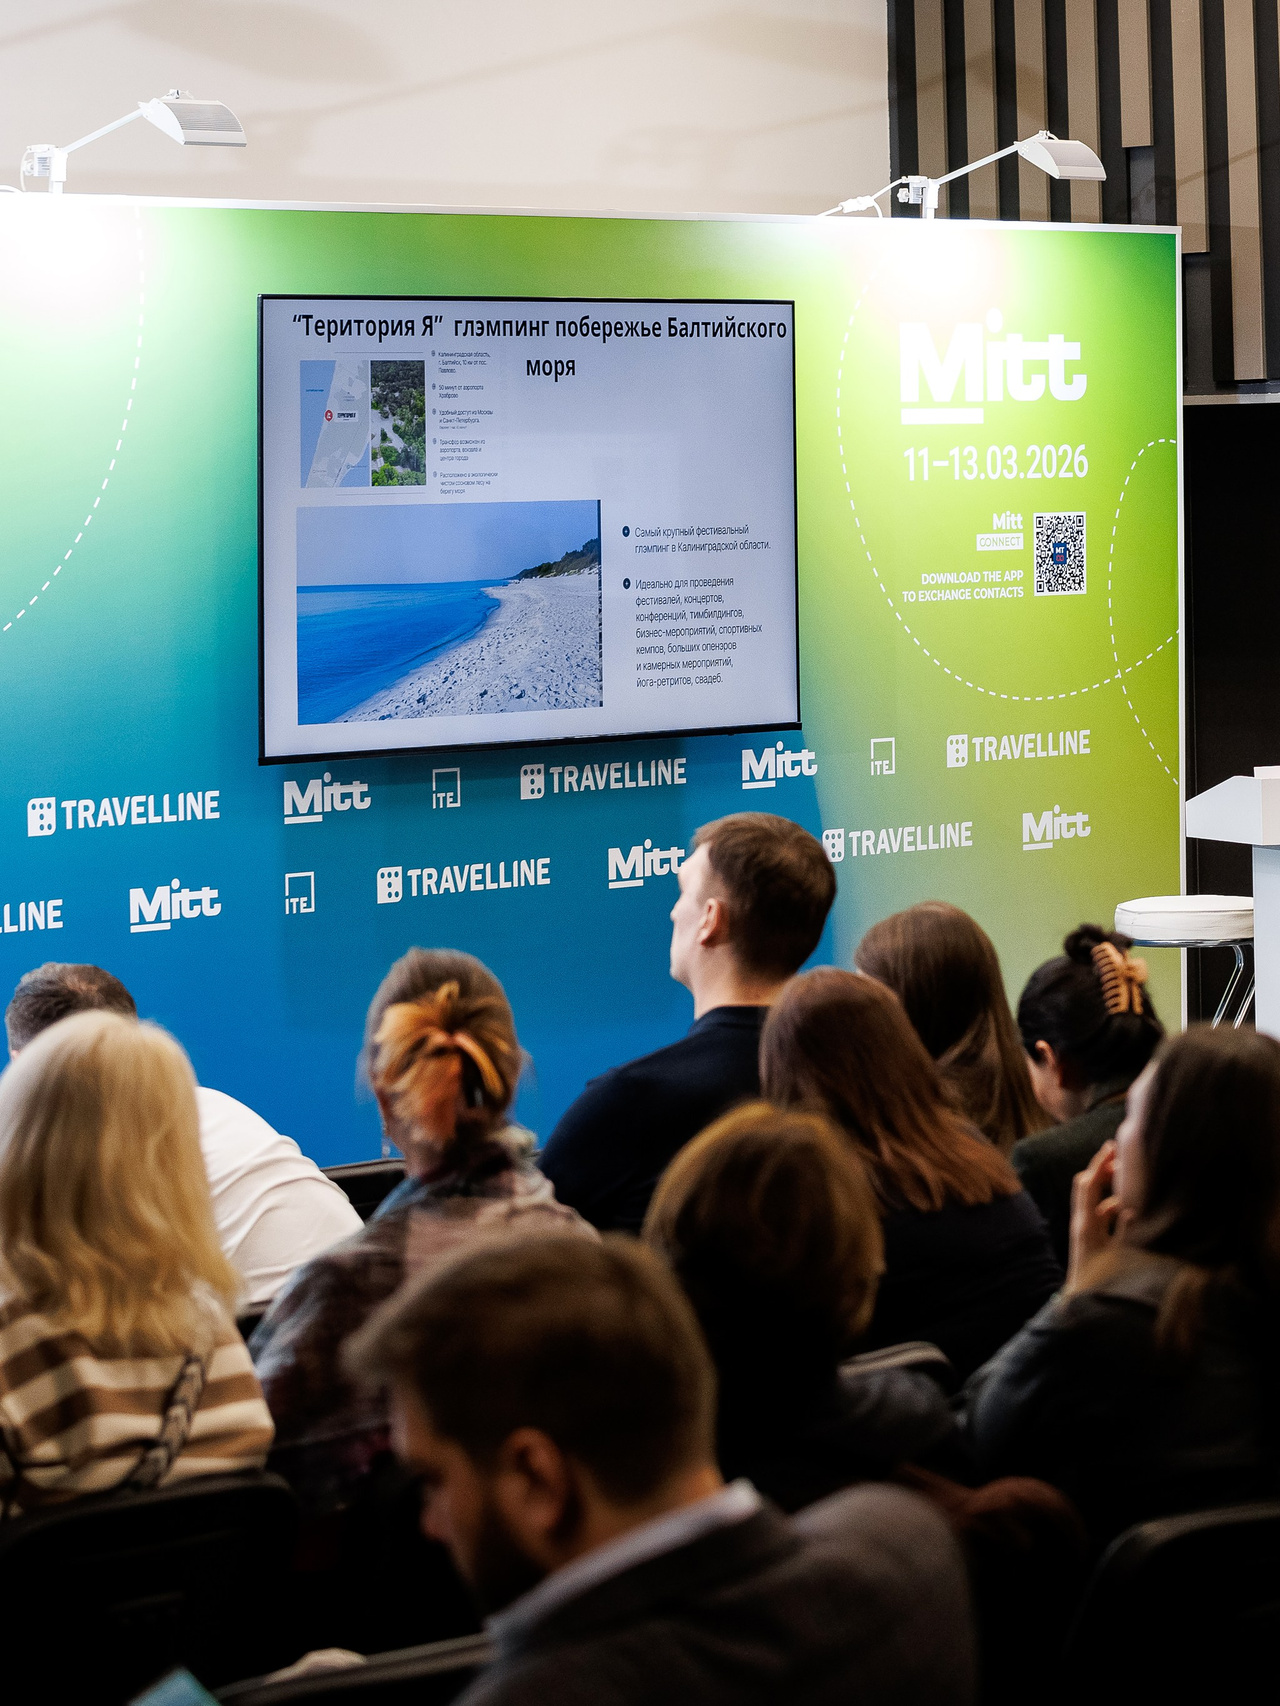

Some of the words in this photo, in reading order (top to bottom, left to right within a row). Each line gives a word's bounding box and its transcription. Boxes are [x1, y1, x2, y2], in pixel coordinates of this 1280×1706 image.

[454, 319, 550, 337] глэмпинг
[555, 315, 662, 344] побережье
[667, 316, 787, 338] Балтийского
[900, 308, 1087, 404] Mitt
[526, 359, 576, 383] моря
[992, 511, 1023, 531] Mitt
[634, 526, 661, 538] Самый
[662, 525, 695, 540] крупный
[695, 524, 750, 538] фестивальный
[978, 535, 1021, 548] CONNECT
[634, 544, 670, 555] глэмпинг
[671, 544, 677, 553] в
[739, 540, 771, 551] области.
[635, 579, 673, 591] Идеально
[674, 578, 688, 589] для
[689, 576, 734, 589] проведения
[921, 571, 981, 585] DOWNLOAD
[982, 570, 1001, 583] THE
[1003, 570, 1023, 582] APP
[635, 593, 683, 607] фестивалей,
[684, 592, 725, 605] концертов,
[902, 590, 917, 603] TO
[918, 588, 971, 602] EXCHANGE
[973, 586, 1024, 600] CONTACTS
[635, 609, 688, 623] конференций,
[689, 607, 744, 620] тимбилдингов,
[635, 625, 718, 638] бизнес-мероприятий,
[718, 622, 763, 636] спортивных
[636, 644, 666, 656] кемпов,
[667, 641, 701, 654] больших
[701, 641, 737, 653] опенэров
[636, 663, 642, 671] и
[642, 660, 681, 671] камерных
[682, 656, 734, 670] мероприятий,
[636, 675, 694, 688] йога-ретритов,
[695, 673, 724, 686] свадеб.
[972, 729, 1091, 762] TRAVELLINE
[742, 740, 818, 783] Mitt
[870, 760, 895, 776] ITE
[549, 757, 687, 794] TRAVELLINE
[283, 772, 372, 817] Mitt
[432, 792, 461, 809] ITE
[61, 790, 221, 830] TRAVELLINE
[1022, 804, 1092, 845] Mitt
[849, 821, 973, 857] TRAVELLINE
[608, 838, 685, 883] Mitt
[407, 857, 551, 897] TRAVELLINE
[129, 878, 222, 926] Mitt
[285, 896, 315, 915] ITE
[0, 898, 63, 934] LINE
